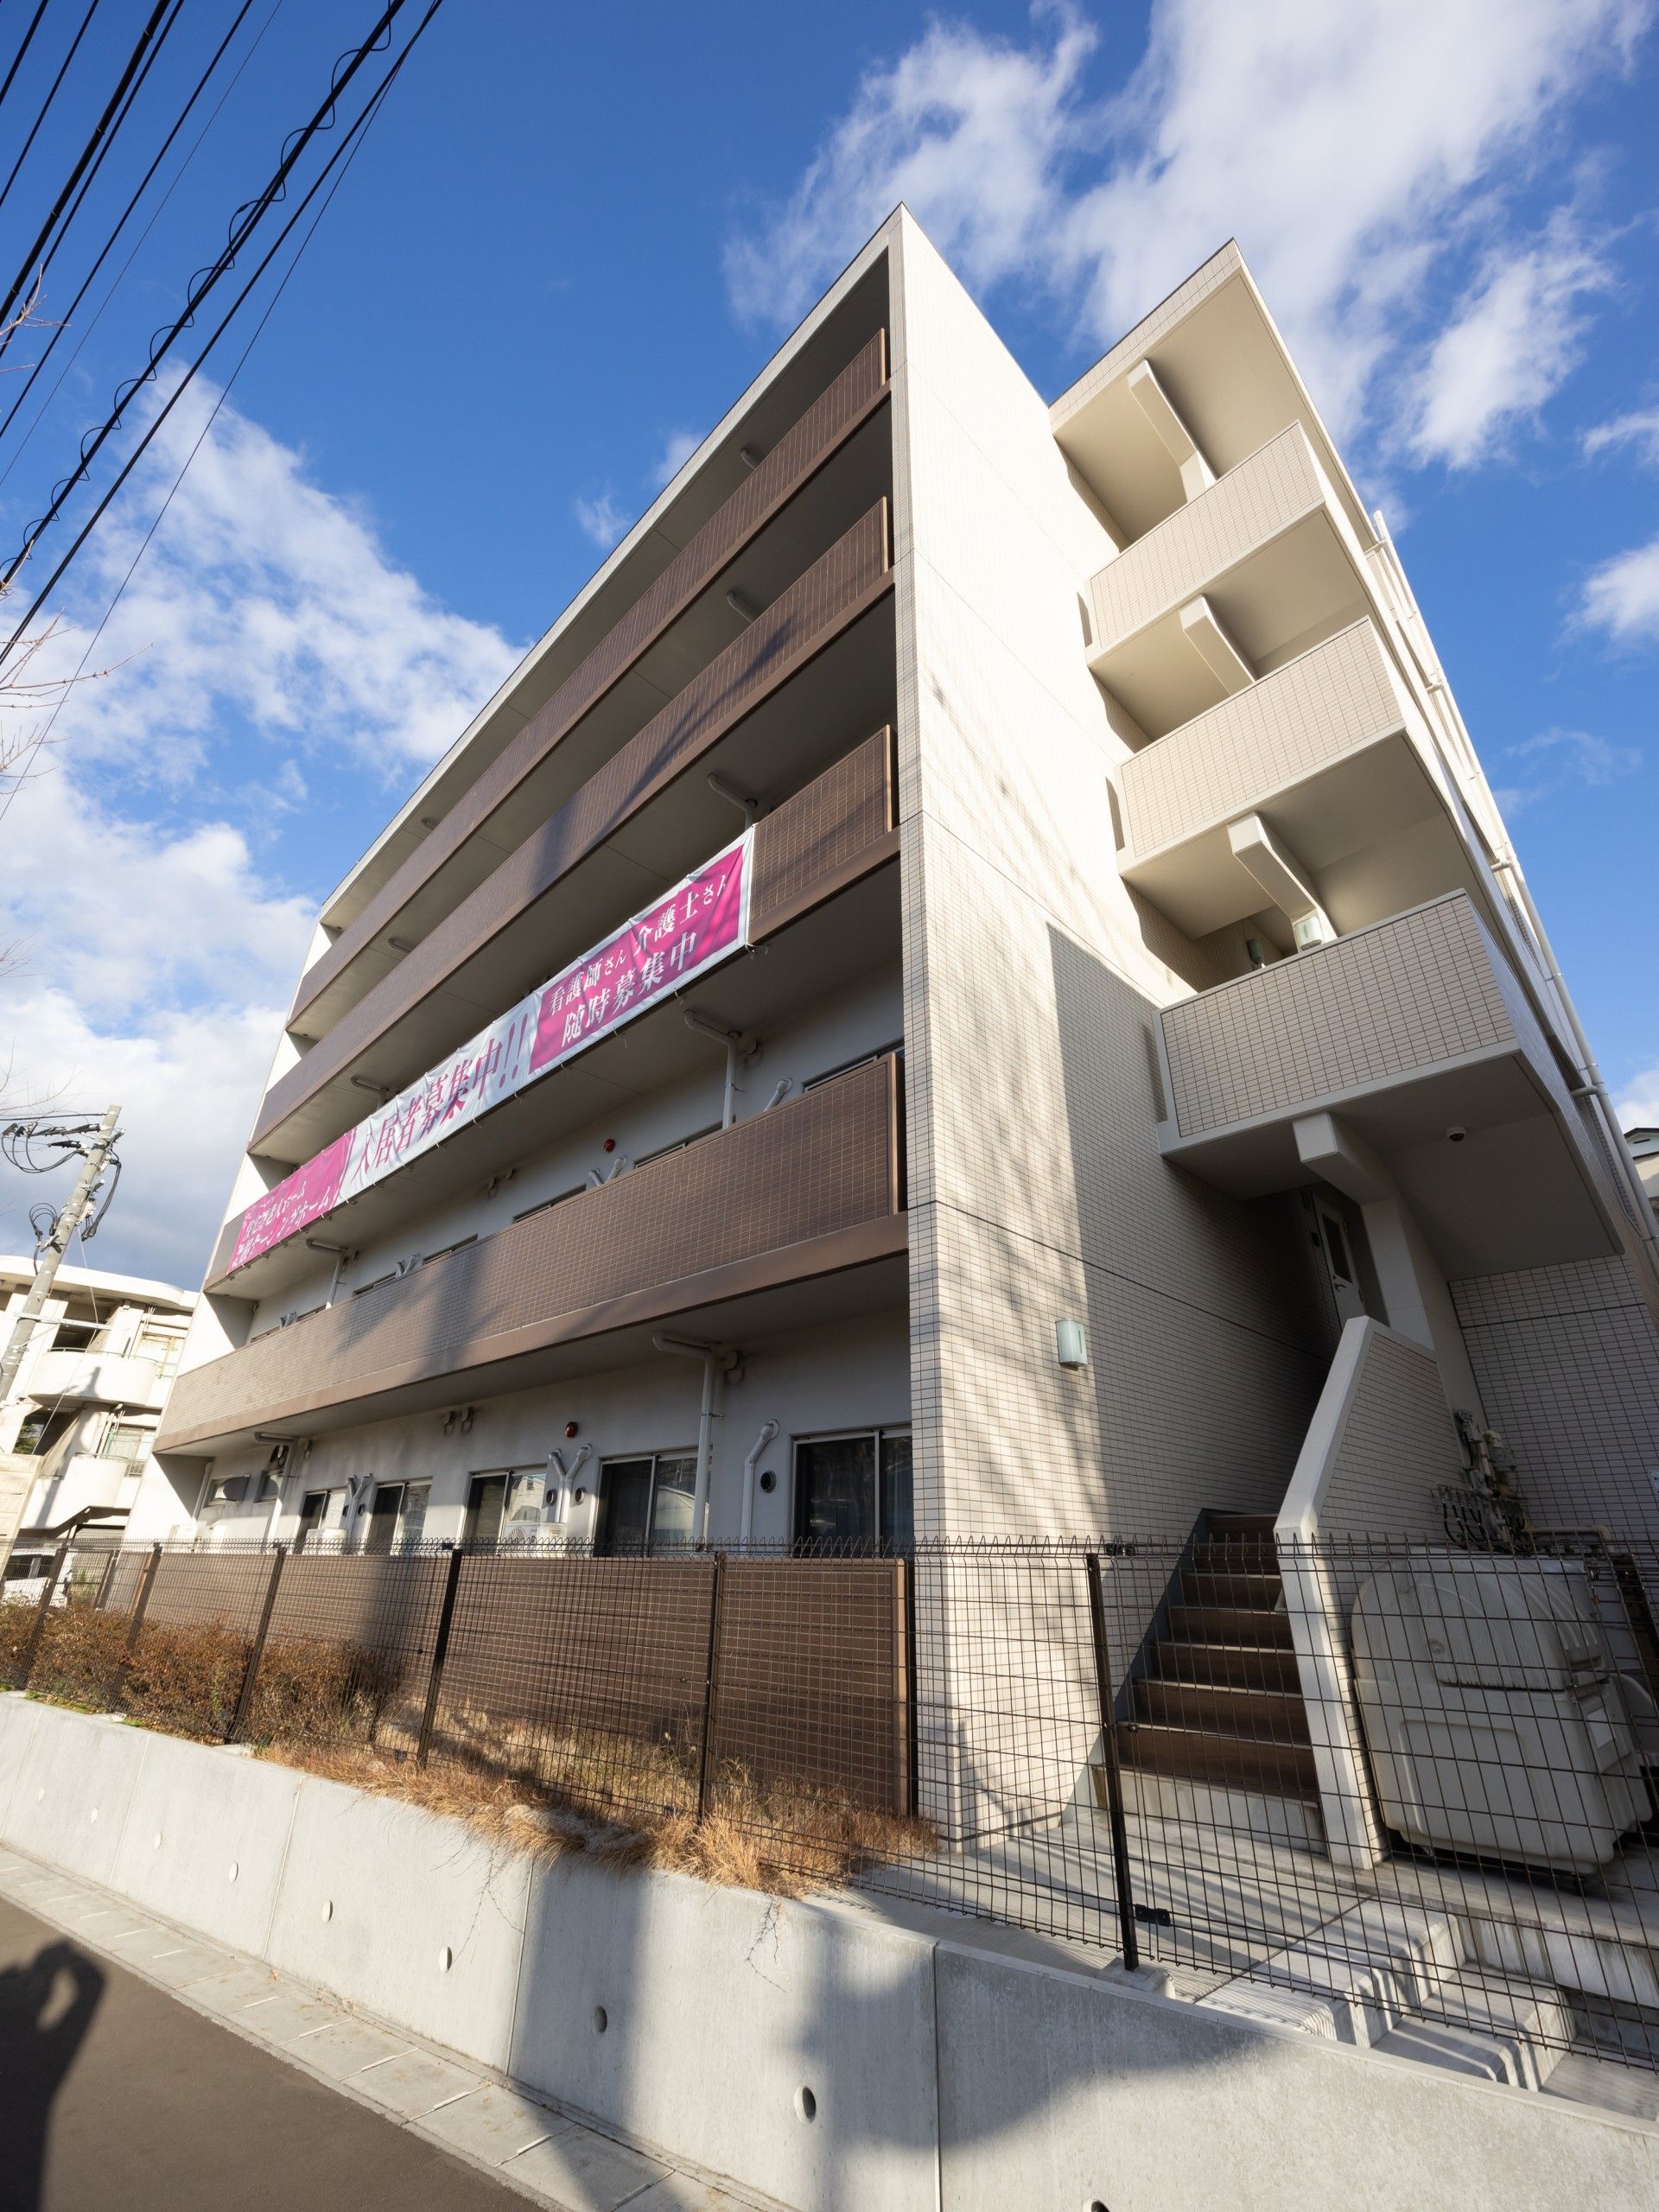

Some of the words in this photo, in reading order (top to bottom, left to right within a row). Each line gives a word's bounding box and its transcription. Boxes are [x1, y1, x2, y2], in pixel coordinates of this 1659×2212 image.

[550, 949, 628, 1016] 看護師さん
[633, 874, 728, 957] 介護士さん
[561, 931, 697, 1048] 随時募集中
